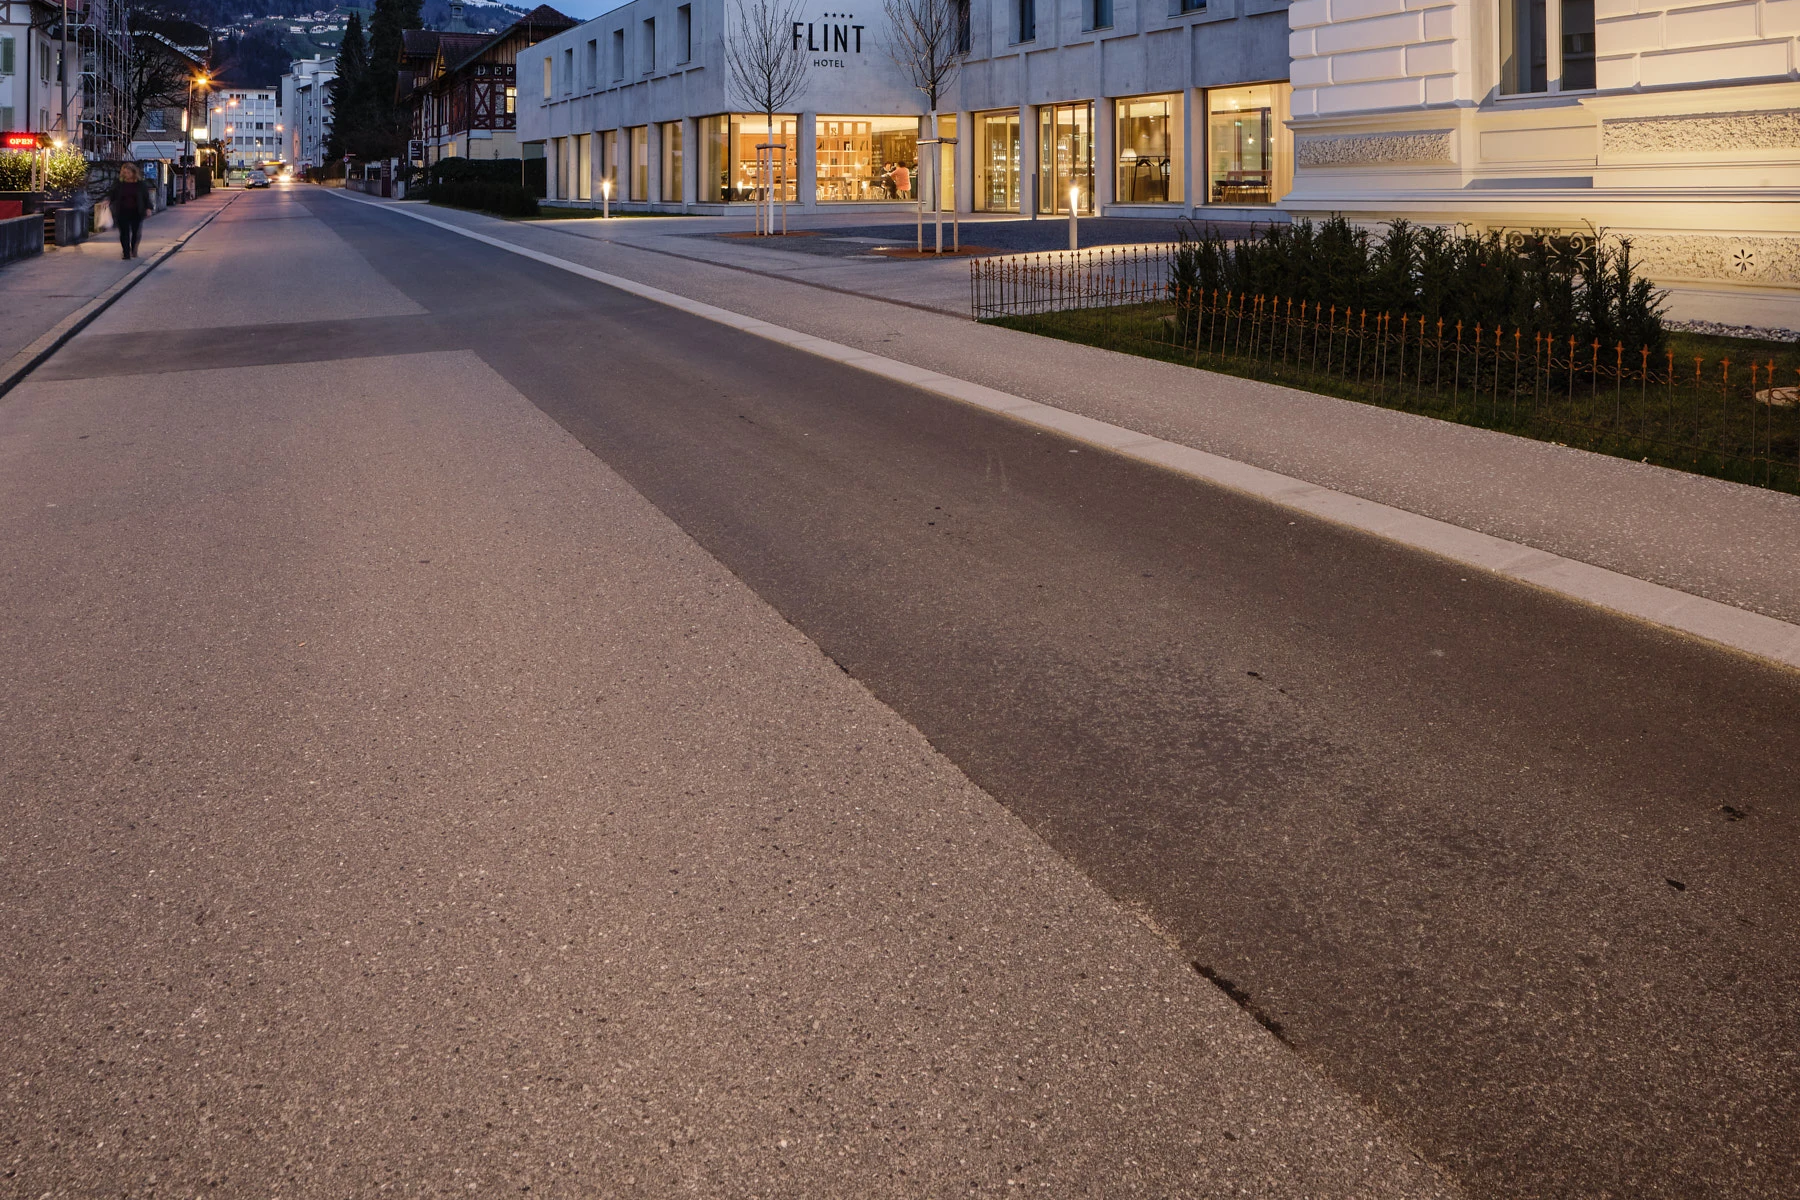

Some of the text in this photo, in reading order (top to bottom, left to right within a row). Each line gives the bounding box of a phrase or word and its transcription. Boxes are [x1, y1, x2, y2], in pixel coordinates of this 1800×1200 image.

[792, 22, 865, 53] FLINT
[813, 59, 845, 68] HOTEL
[146, 162, 154, 172] P
